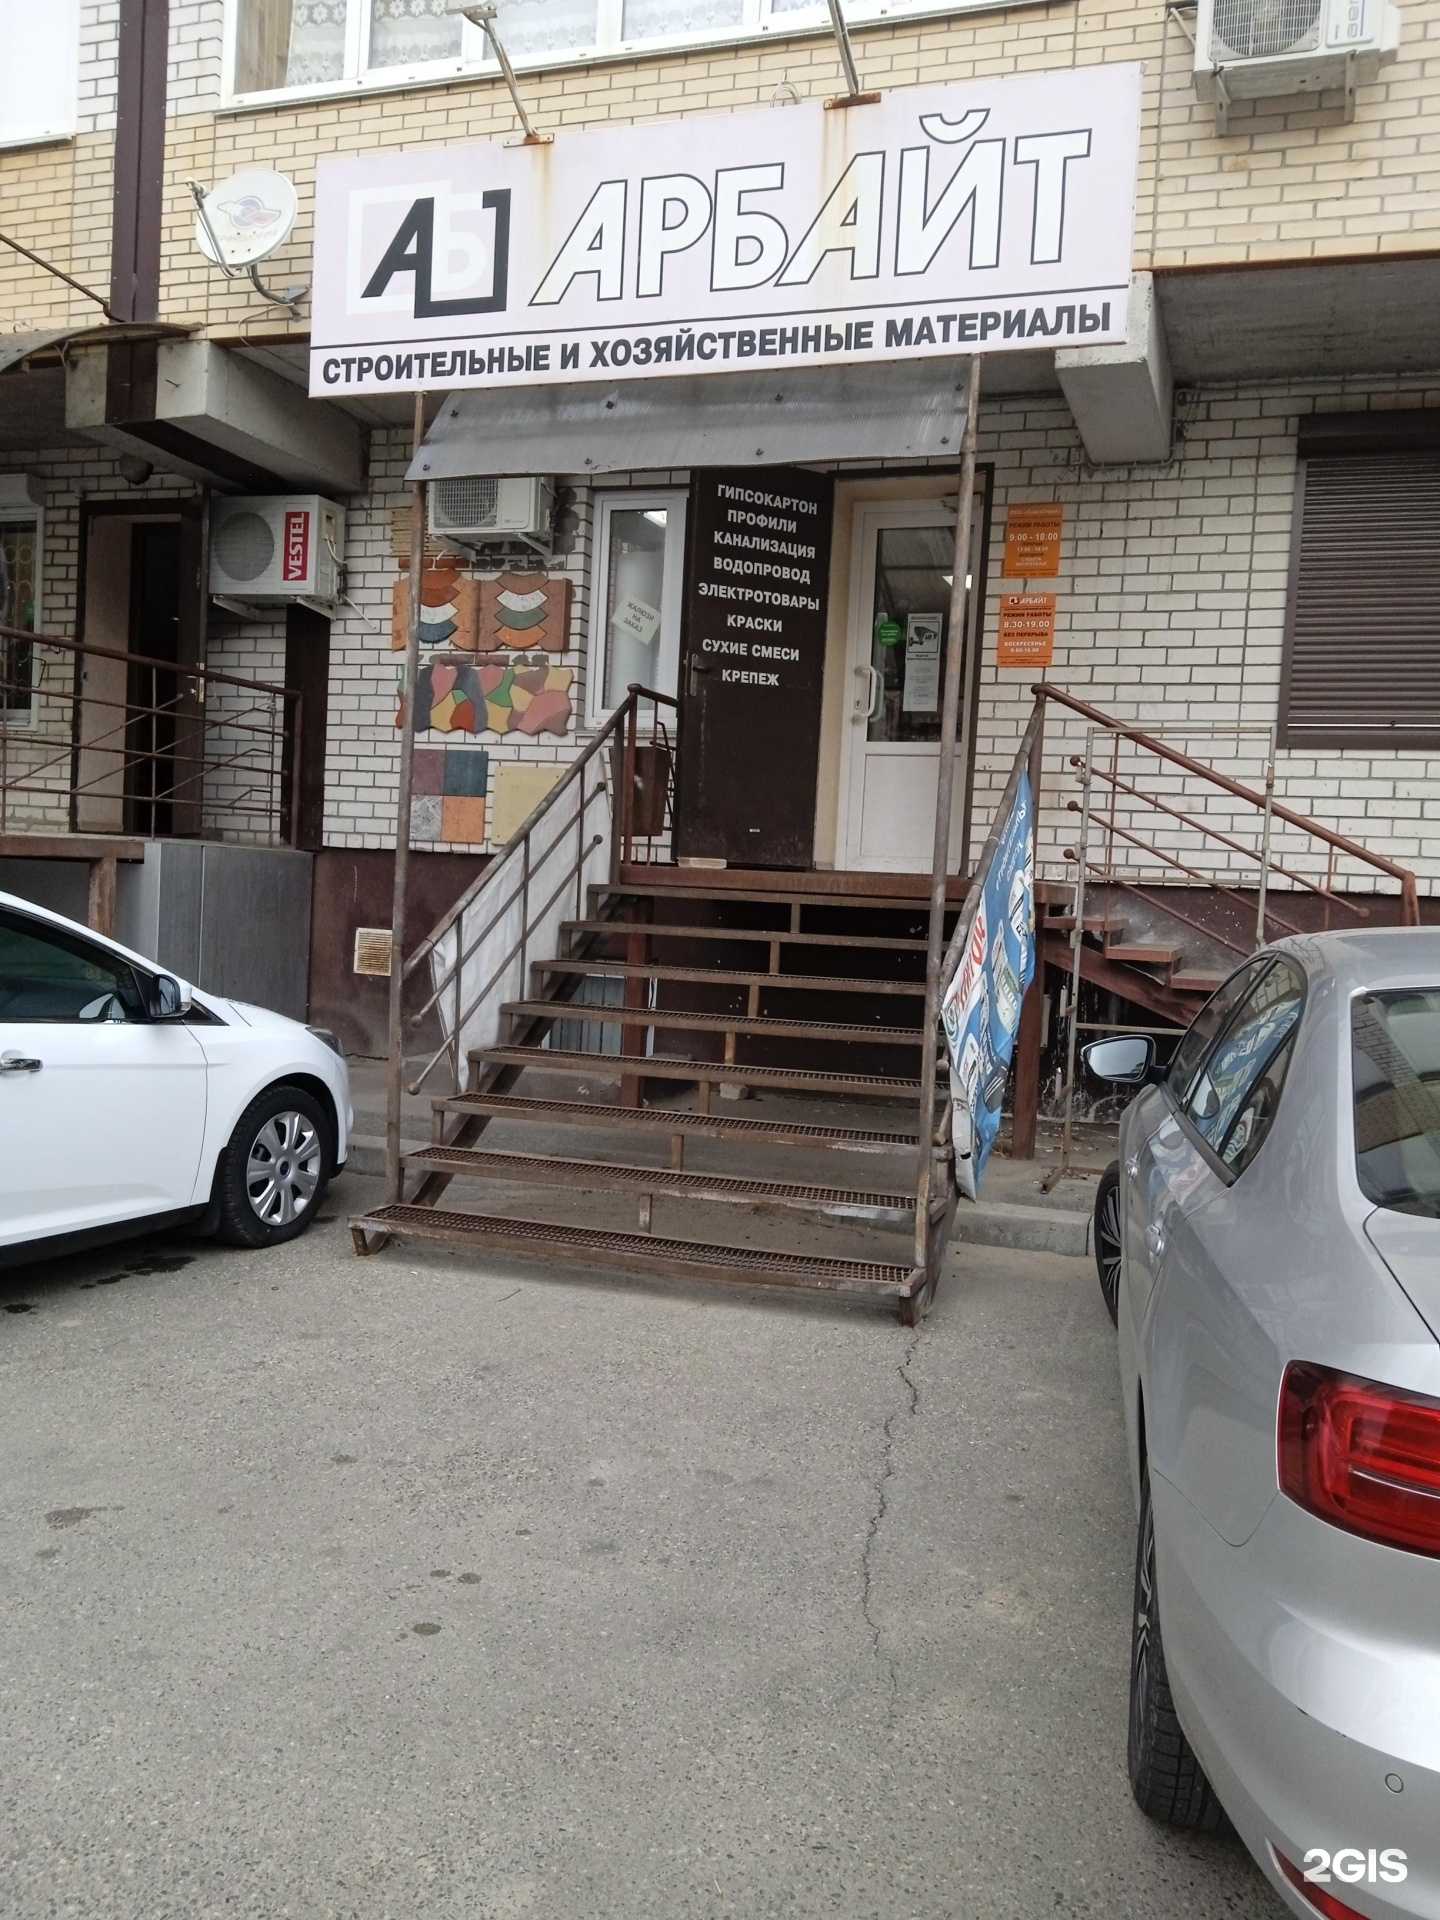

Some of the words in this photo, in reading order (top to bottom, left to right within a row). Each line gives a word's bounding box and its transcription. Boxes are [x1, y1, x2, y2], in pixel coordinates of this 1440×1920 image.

[530, 108, 1092, 306] АРБАЙТ
[323, 344, 550, 383] СТРОИТЕЛЬНЫЕ
[560, 343, 579, 369] И
[590, 321, 873, 367] ХОЗЯЙСТВЕННЫЕ
[884, 302, 1111, 347] МАТЕРИАЛЫ
[717, 484, 818, 515] ГИПСОКАРТОН
[727, 509, 797, 533] ПРОФИЛИ
[288, 512, 305, 580] VESTEL
[714, 531, 815, 559] КАНАЛИЗАЦИЯ
[714, 556, 811, 585] ВОДОПРОВОД
[698, 582, 819, 611] ЭЛЕКТРОТОВАРЫ
[727, 614, 782, 632] КРАСКИ
[702, 638, 748, 656] СУХИЕ
[752, 644, 800, 661] СМЕСИ
[721, 669, 779, 686] КРЕПЕЖ
